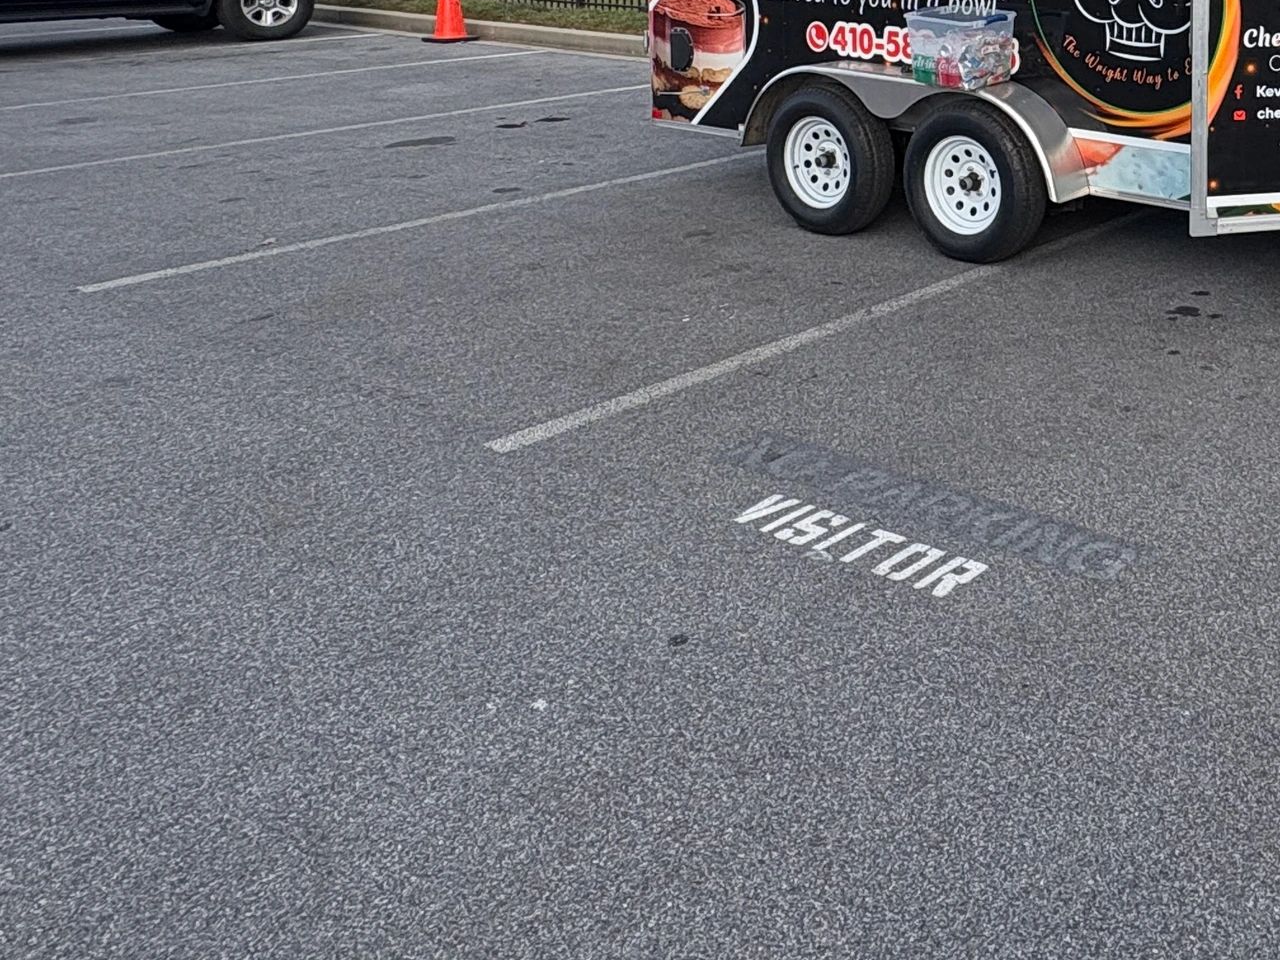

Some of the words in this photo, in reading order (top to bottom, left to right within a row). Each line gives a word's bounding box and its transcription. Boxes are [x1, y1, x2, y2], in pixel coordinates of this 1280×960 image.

[1062, 34, 1081, 59] The
[1085, 52, 1128, 82] Wright
[1133, 69, 1163, 90] Way
[1167, 66, 1180, 81] to
[732, 493, 990, 598] VISITOR
